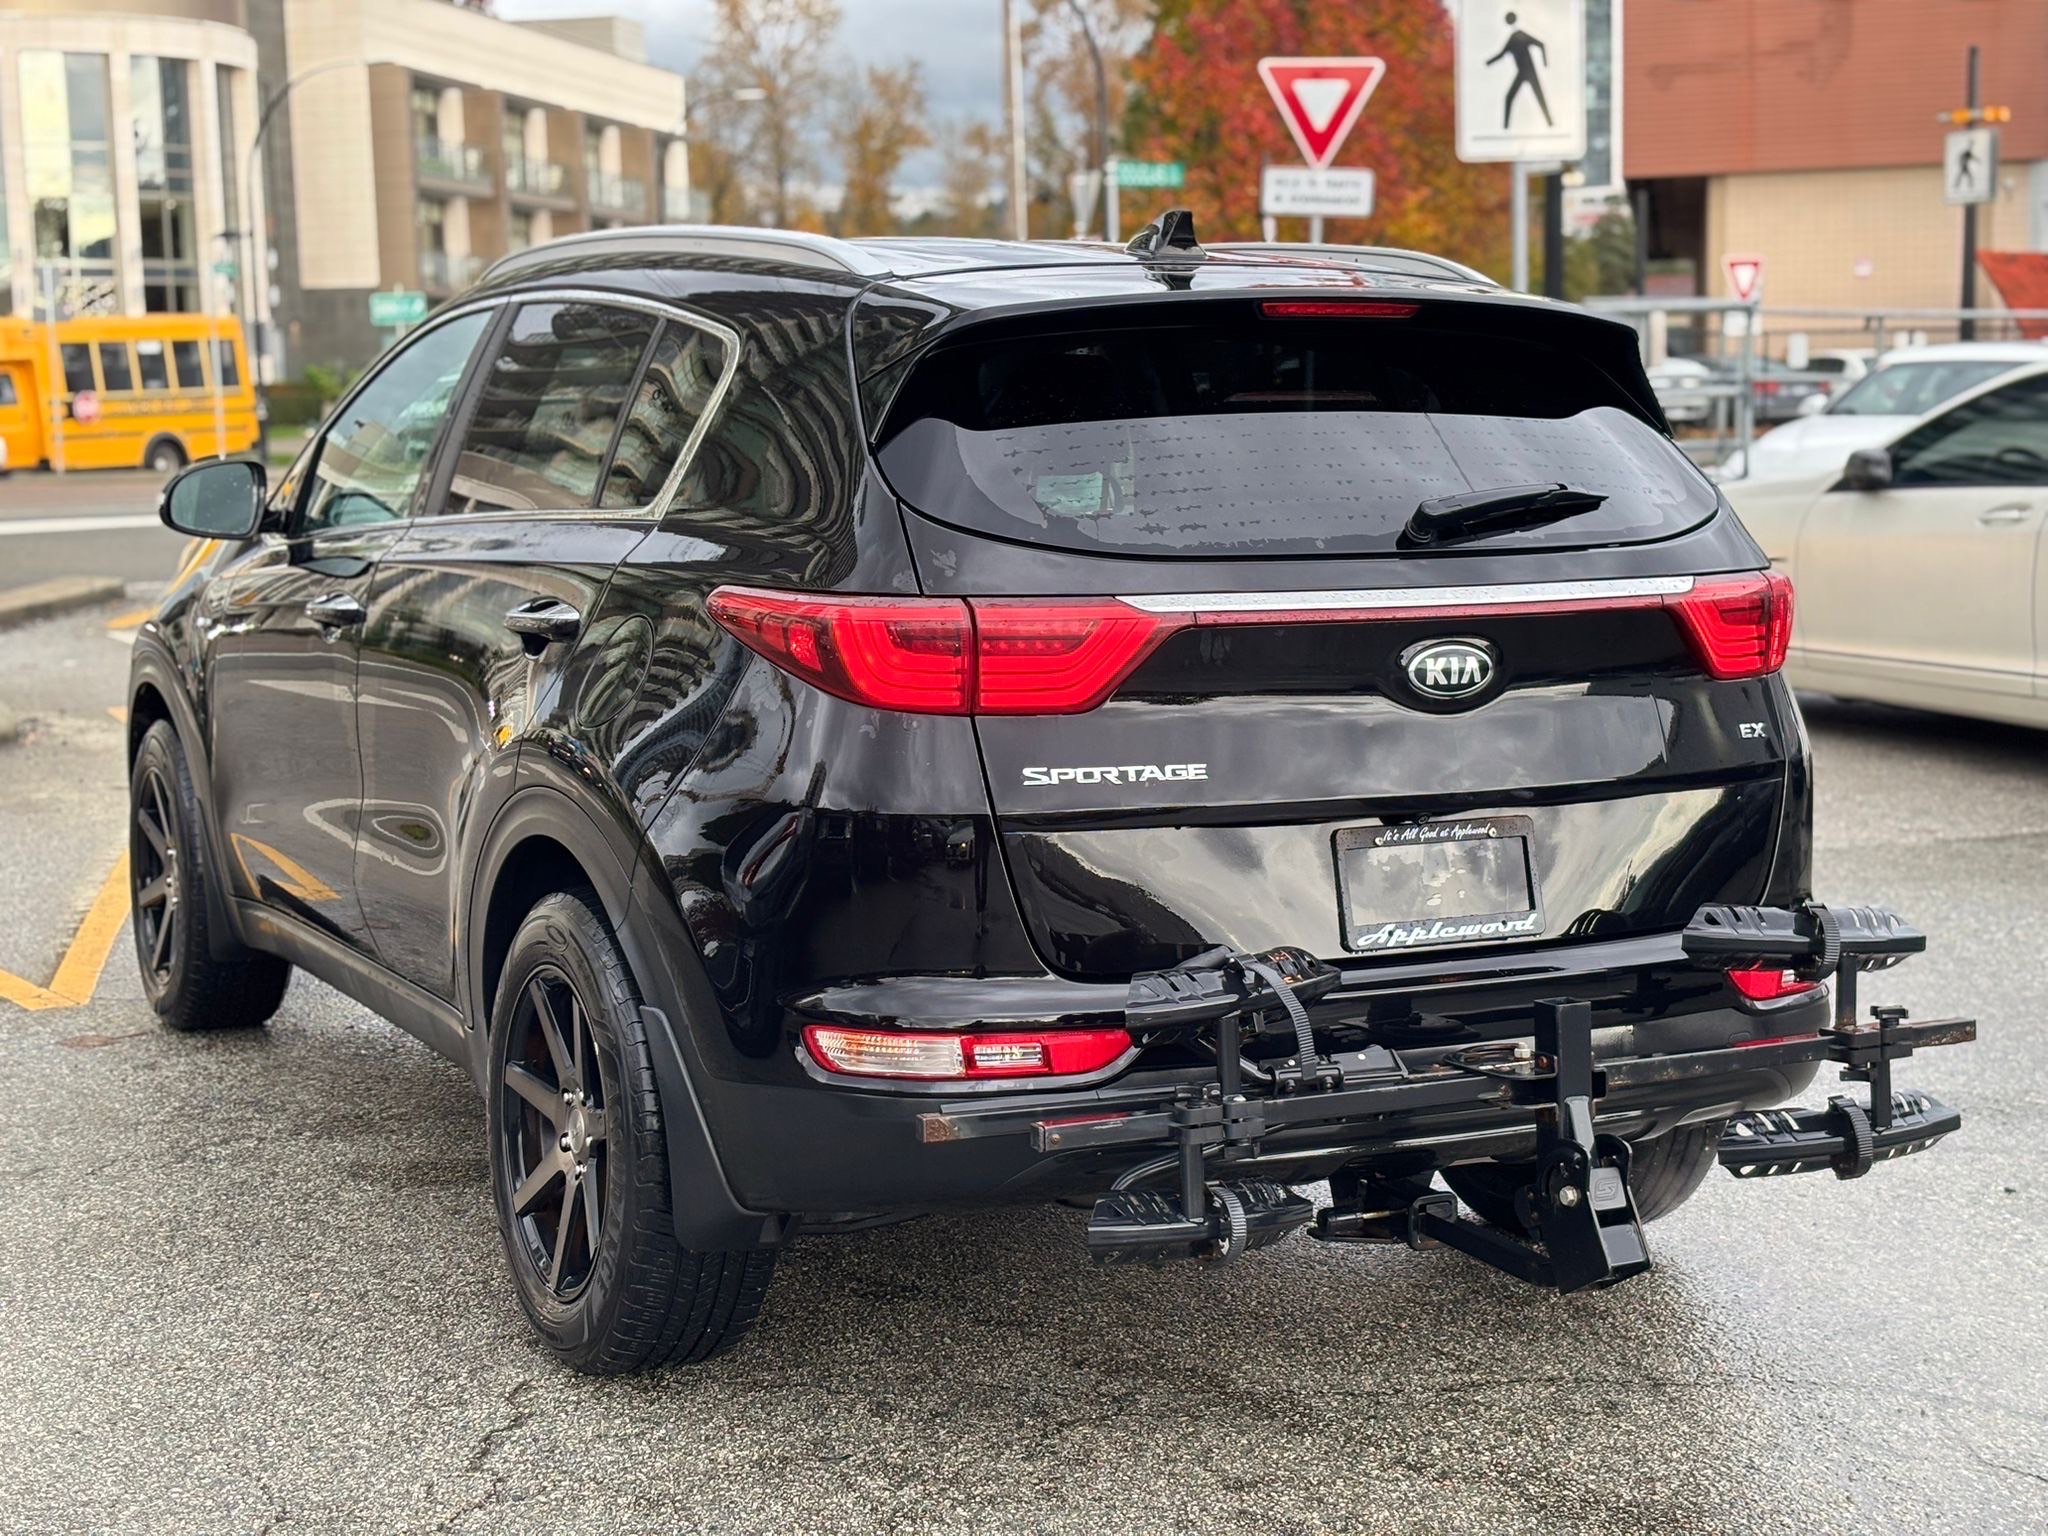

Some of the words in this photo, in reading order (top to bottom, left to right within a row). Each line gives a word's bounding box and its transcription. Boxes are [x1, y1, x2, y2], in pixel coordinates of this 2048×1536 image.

[1424, 656, 1482, 686] KIA
[1739, 722, 1767, 738] EX
[1022, 763, 1209, 786] SPORTAGE
[1383, 830, 1399, 841] It's
[1401, 827, 1418, 840] All
[1419, 826, 1438, 841] Good
[1440, 828, 1450, 839] at
[1450, 823, 1491, 839] Applewood
[1357, 913, 1537, 946] Applewood
